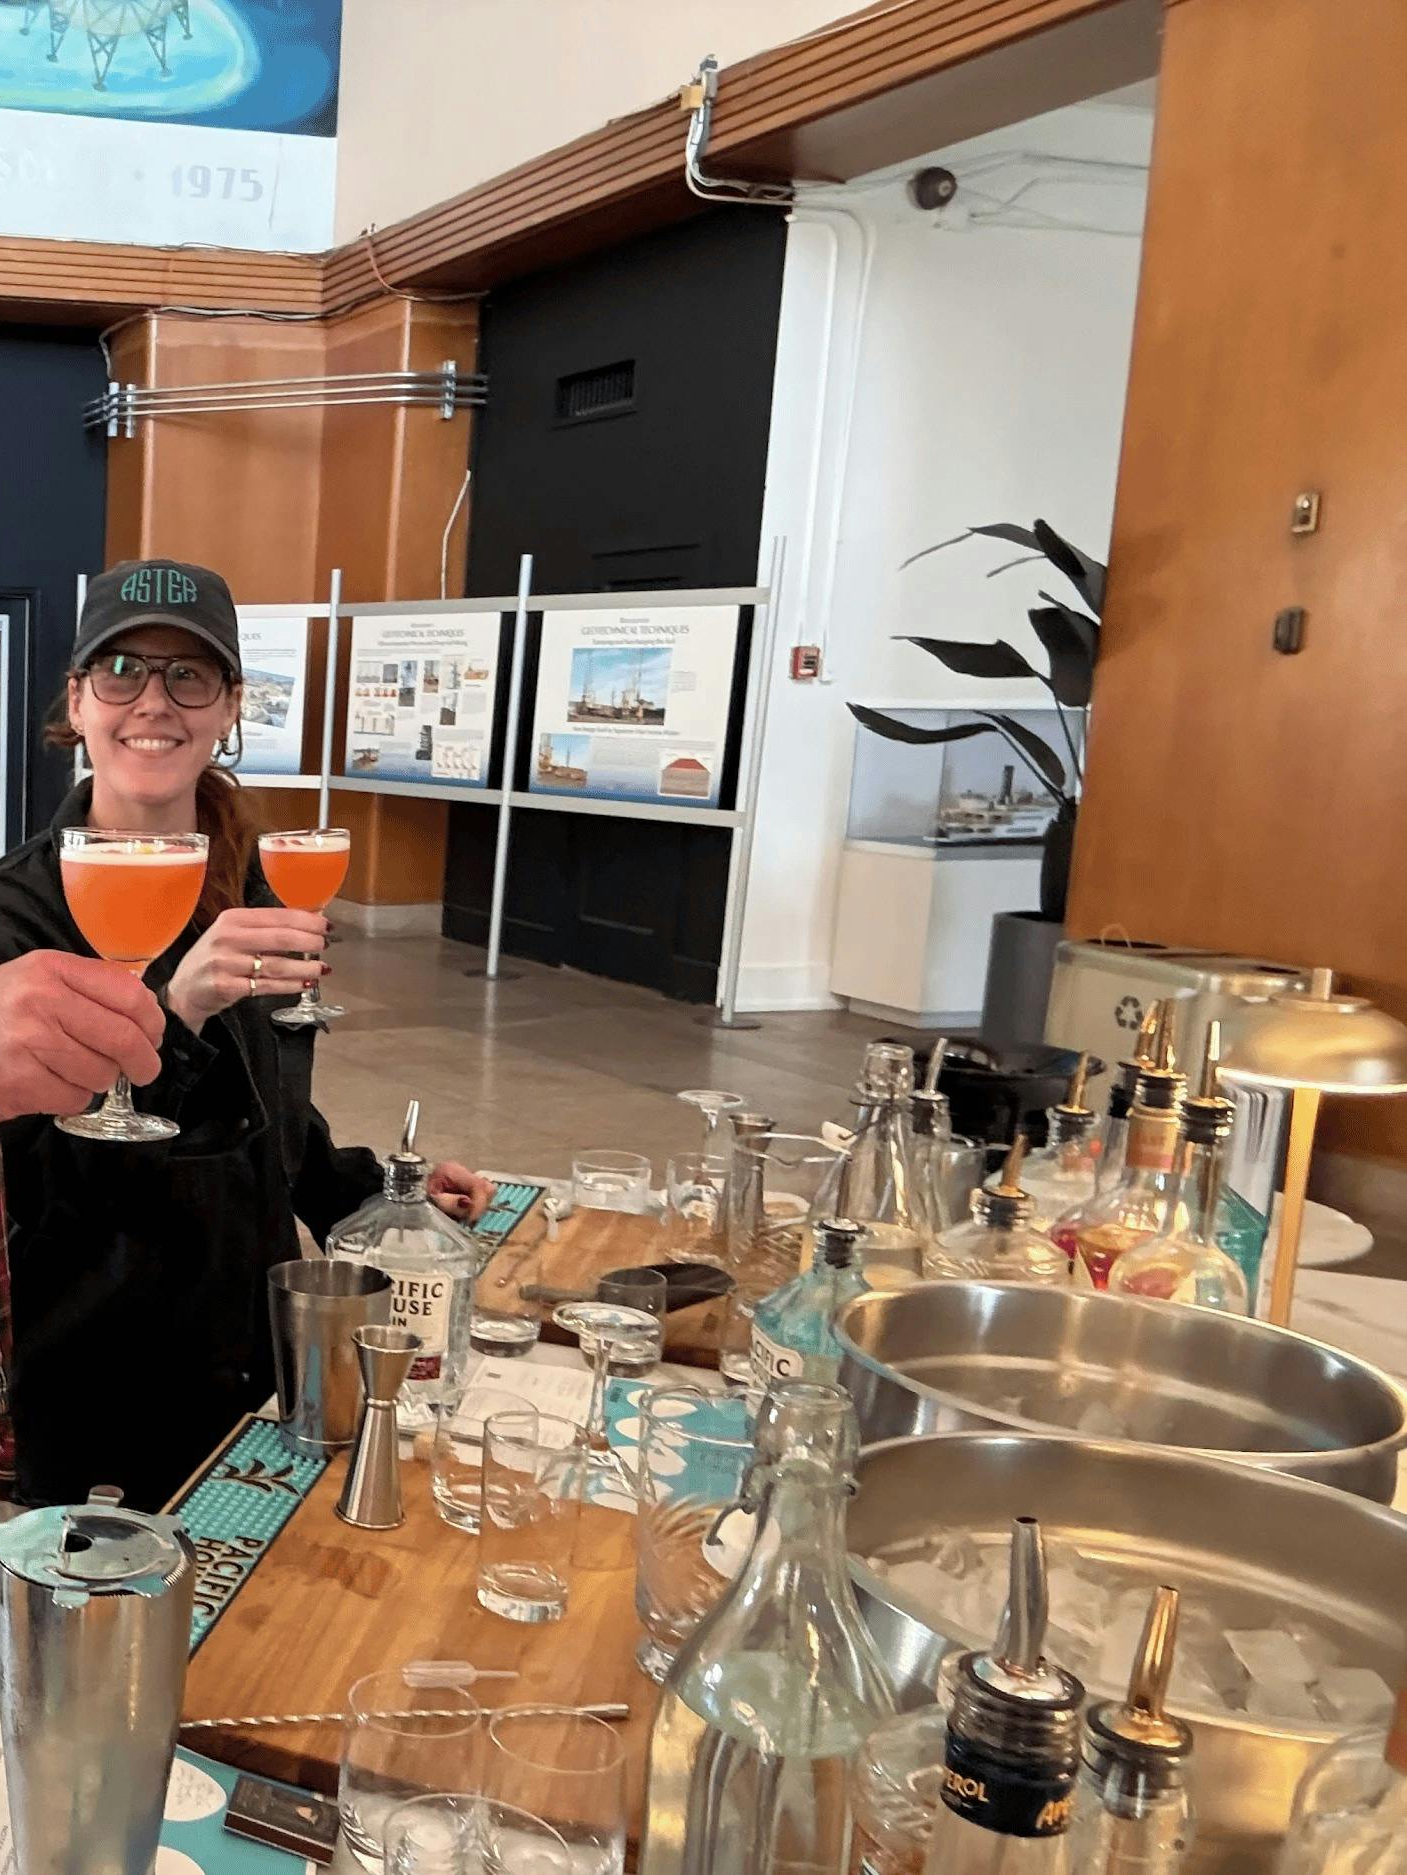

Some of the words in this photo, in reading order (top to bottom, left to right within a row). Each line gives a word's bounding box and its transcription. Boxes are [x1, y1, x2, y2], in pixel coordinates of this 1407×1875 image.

[170, 163, 264, 203] 1975
[120, 567, 198, 604] ASTER
[391, 1316, 407, 1327] IN
[393, 1298, 433, 1316] USE
[193, 1535, 266, 1617] PACIFIC
